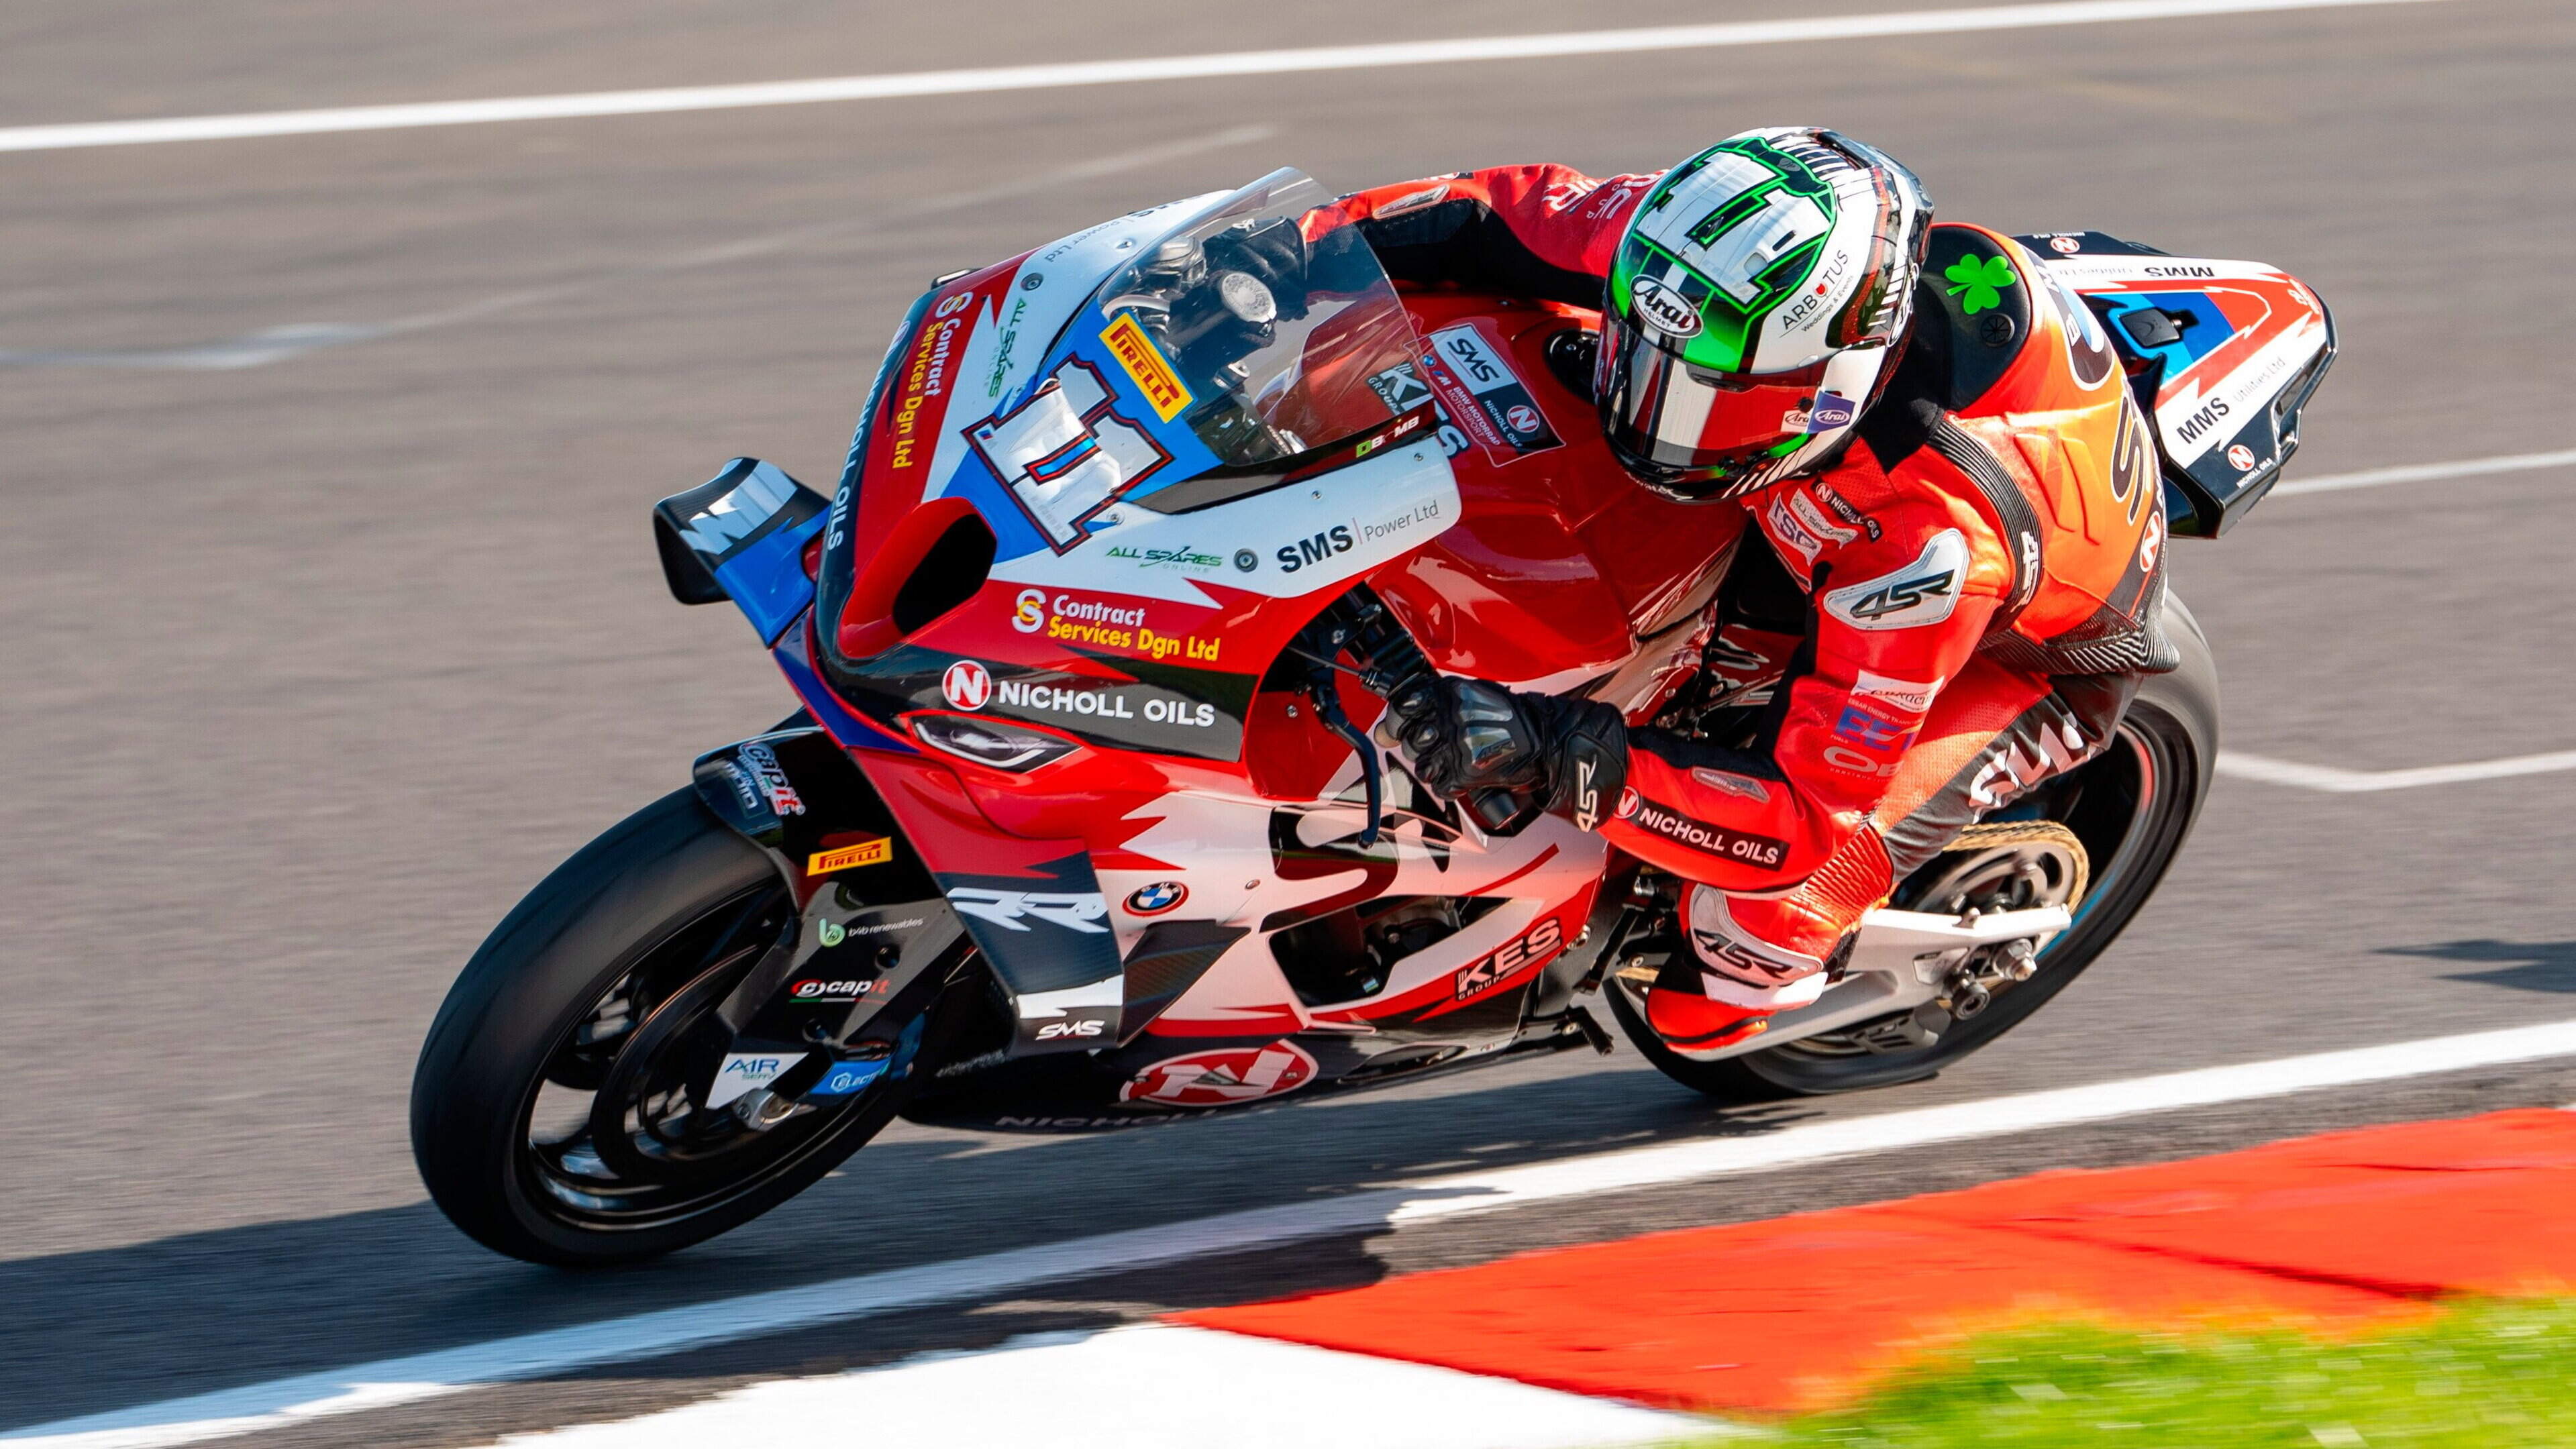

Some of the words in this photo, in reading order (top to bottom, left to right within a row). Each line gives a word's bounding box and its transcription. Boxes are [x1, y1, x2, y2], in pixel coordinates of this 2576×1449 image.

[2145, 266, 2215, 277] MMS
[1634, 284, 1694, 329] Arai
[1643, 308, 1671, 329] HELMET
[1801, 305, 1833, 333] Weddings
[908, 321, 943, 391] Services
[924, 318, 961, 396] Contract
[1108, 323, 1180, 408] PIRELLI
[1447, 338, 1499, 382] SMS
[896, 396, 924, 435] Dgn
[1445, 389, 1485, 439] MOTORSPORT
[1453, 386, 1472, 411] BMW
[1467, 405, 1500, 446] MOTORRAD
[1484, 399, 1510, 432] NICHOLL
[1820, 411, 1846, 421] Arai
[2176, 397, 2230, 445] MMS
[892, 439, 915, 469] Ltd
[827, 486, 851, 551] OILS
[1364, 514, 1411, 543] Power
[1413, 499, 1439, 524] Ltd
[1105, 547, 1141, 559] ALL
[1144, 545, 1223, 567] SPARES
[1276, 525, 1354, 574] SMS
[1052, 594, 1145, 627] Contract
[1047, 616, 1131, 648] Services
[1137, 628, 1181, 660] Dgn
[1186, 636, 1221, 661] Ltd
[998, 680, 1134, 720] NICHOLL
[1143, 699, 1215, 727] OILS
[819, 843, 881, 870] PIRELLI
[1639, 808, 1724, 851] NICHOLL
[1732, 840, 1779, 865] OILS
[869, 917, 925, 933] renewables
[1458, 919, 1560, 994] KES
[826, 979, 891, 996] capit
[1458, 975, 1500, 1001] GROUP
[1035, 1020, 1105, 1040] SMS
[725, 1058, 780, 1073] AIR
